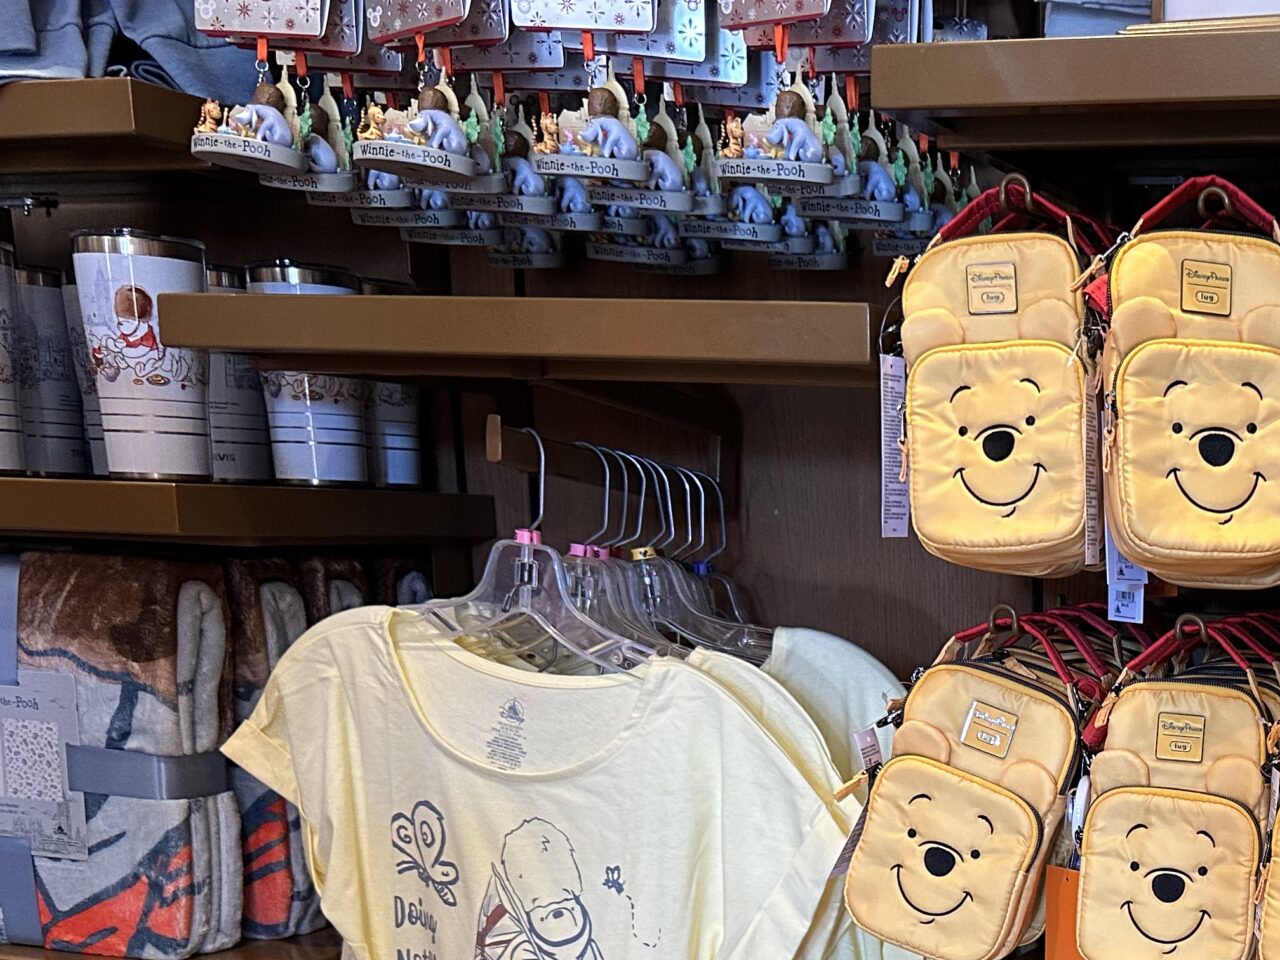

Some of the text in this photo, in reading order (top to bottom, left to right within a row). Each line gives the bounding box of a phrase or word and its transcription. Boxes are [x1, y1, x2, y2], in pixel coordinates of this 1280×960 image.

[193, 136, 271, 158] Winnie-the-Pooh
[360, 144, 451, 168] Winnie-the-Pooh
[534, 157, 619, 177] Winnie-the-Pooh
[719, 162, 805, 178] Winnie-the-Pooh
[800, 201, 881, 218] Winnie-the-Pooh
[1200, 292, 1214, 302] lug
[394, 895, 437, 944] Doing
